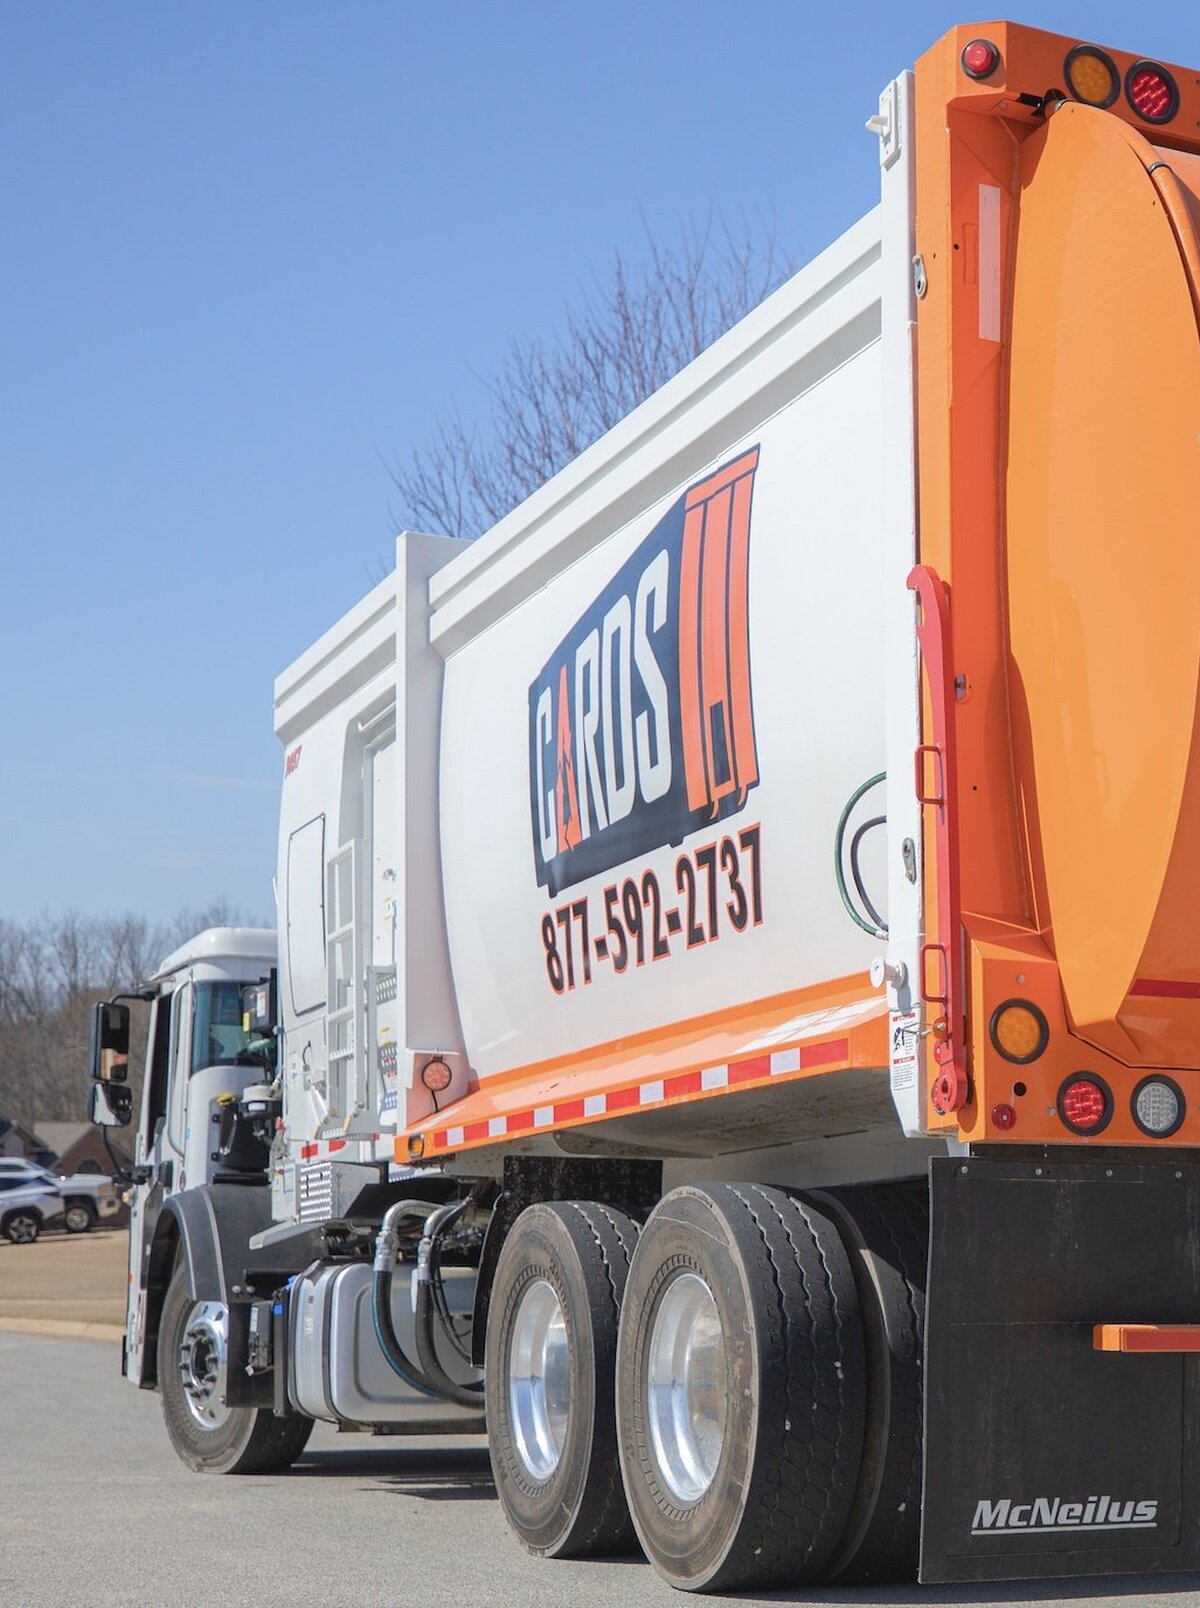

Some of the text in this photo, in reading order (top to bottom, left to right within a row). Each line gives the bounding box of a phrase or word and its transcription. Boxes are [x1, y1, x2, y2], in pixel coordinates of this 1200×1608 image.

[536, 549, 672, 863] CARDS
[541, 821, 764, 995] 877-592-2737
[971, 1496, 1159, 1528] McNeilus
